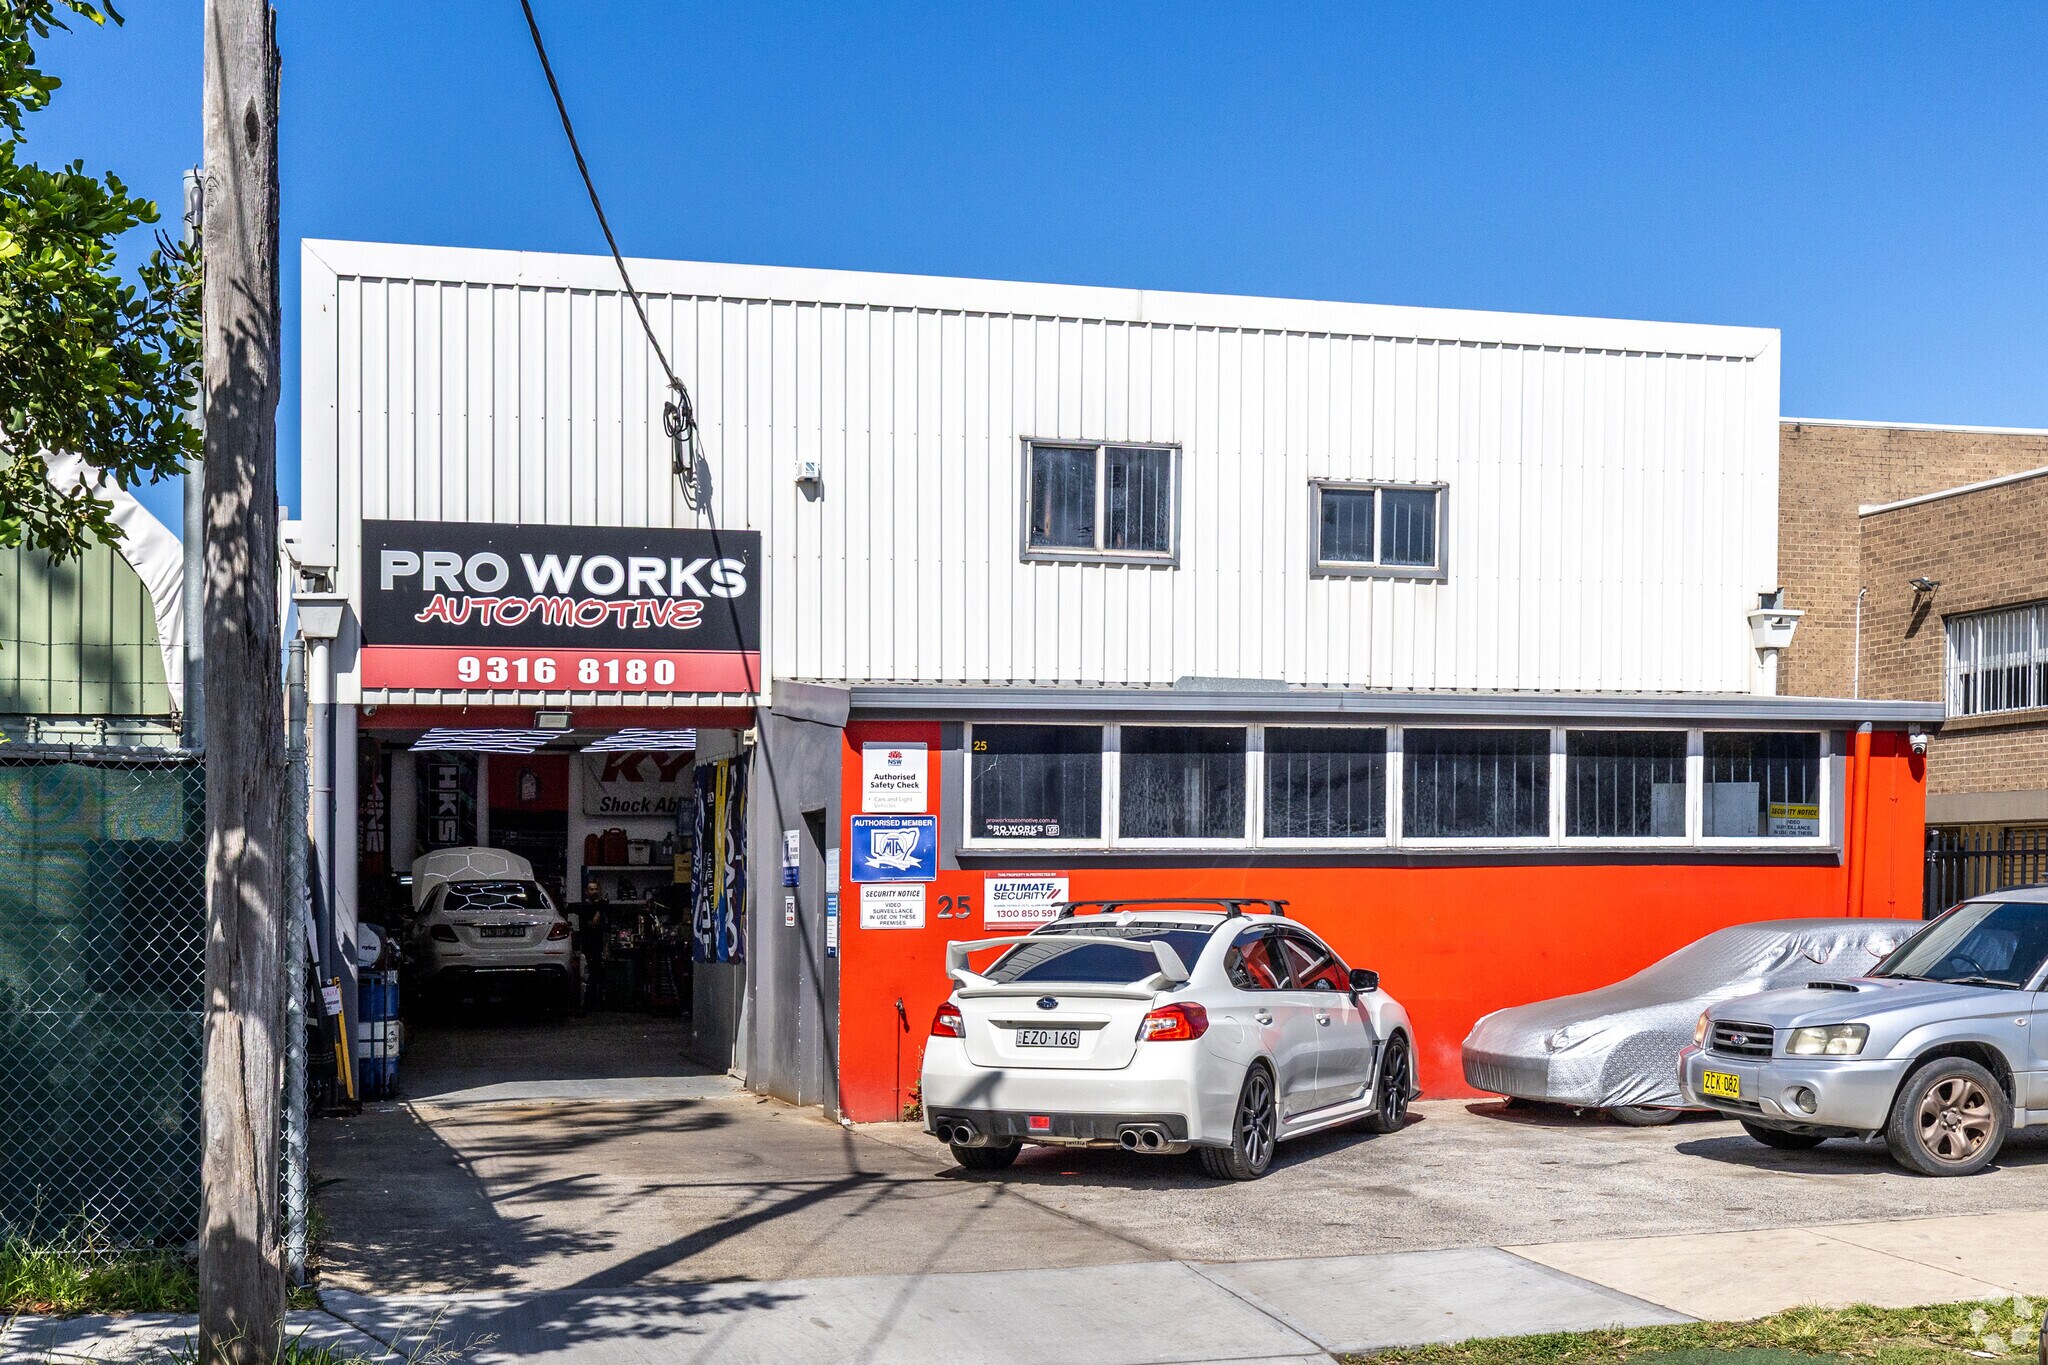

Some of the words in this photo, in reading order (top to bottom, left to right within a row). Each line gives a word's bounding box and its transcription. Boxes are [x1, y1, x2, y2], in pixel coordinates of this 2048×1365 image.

[380, 550, 509, 593] PRO
[520, 553, 747, 598] WORKS
[414, 593, 704, 629] AUTOMOTIVE
[457, 656, 556, 683] 9316
[578, 658, 675, 685] 8180
[974, 741, 988, 750] 25
[601, 749, 696, 782] KY
[438, 766, 457, 841] HKS
[600, 797, 650, 812] Shock
[882, 838, 904, 856] MTA
[993, 892, 1048, 900] SECURITY
[994, 883, 1054, 891] ULTIMATE
[937, 895, 970, 918] 25
